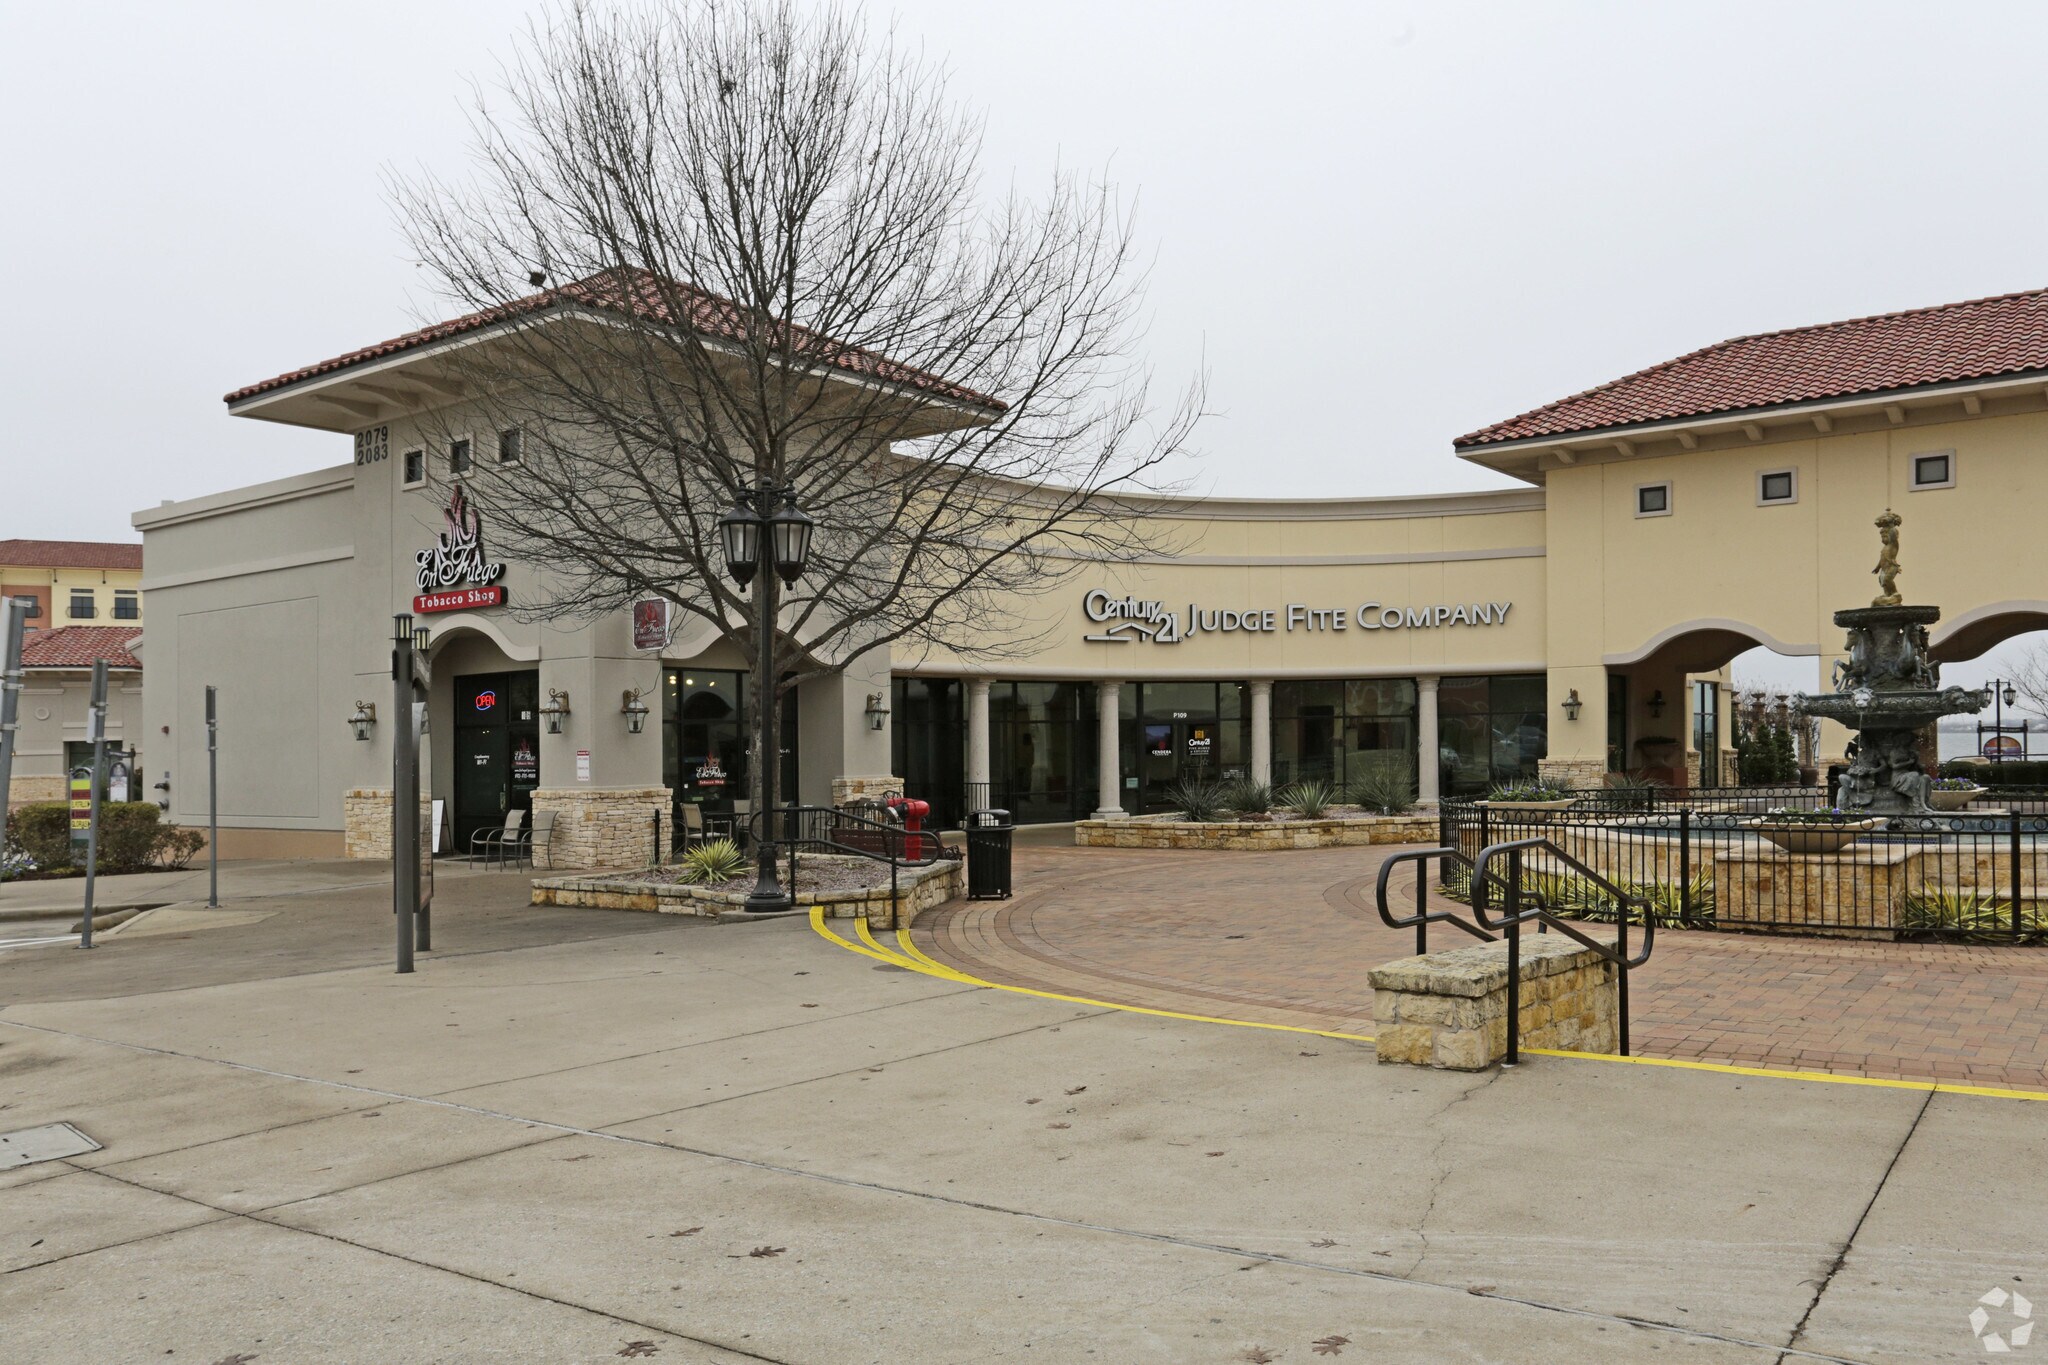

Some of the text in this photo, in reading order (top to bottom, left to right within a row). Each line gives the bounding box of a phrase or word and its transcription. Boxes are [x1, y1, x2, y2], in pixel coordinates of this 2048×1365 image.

[357, 425, 388, 448] 2079
[357, 443, 388, 466] 2083
[415, 543, 500, 592] En Fuego
[420, 591, 495, 608] Tobacco Shop
[1084, 588, 1165, 623] Century
[1185, 603, 1276, 637] JUDGE
[1287, 603, 1348, 631] FITE
[1356, 601, 1513, 630] COMPANY
[475, 695, 496, 707] OPEN
